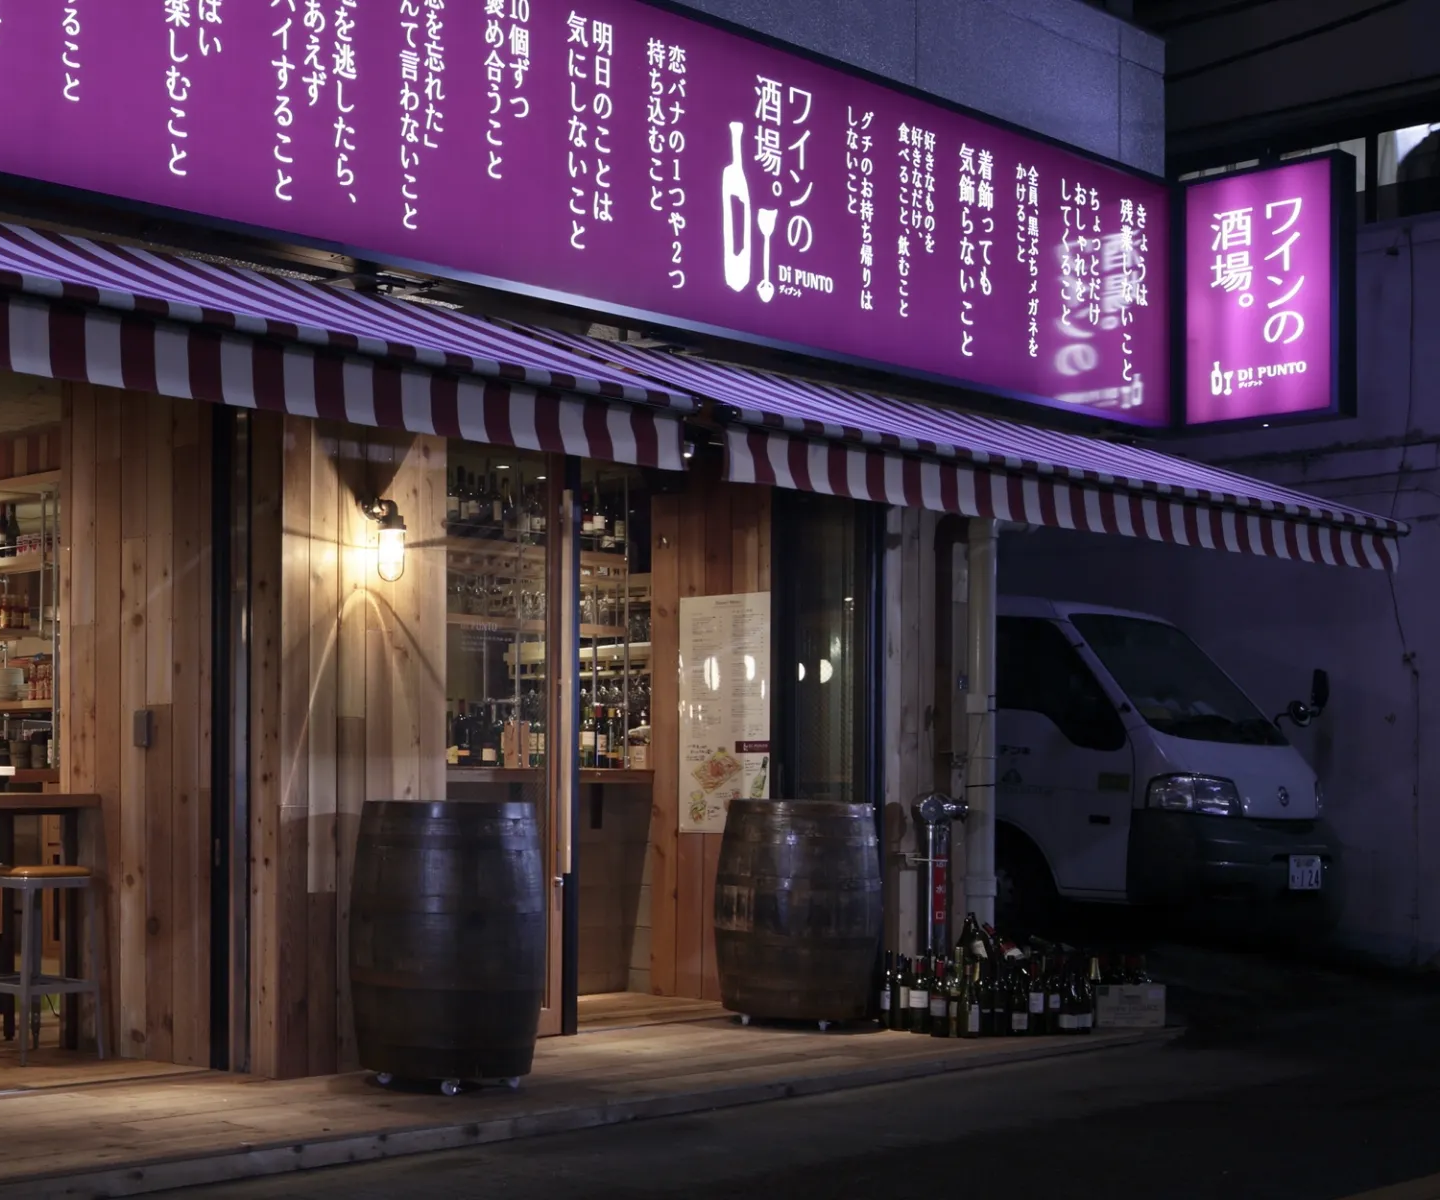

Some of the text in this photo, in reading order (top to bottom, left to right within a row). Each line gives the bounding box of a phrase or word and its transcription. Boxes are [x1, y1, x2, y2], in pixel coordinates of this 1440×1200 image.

[62, 0, 81, 102] ること
[164, 0, 191, 176] 楽しむこと
[331, 0, 357, 203] を逃したら、
[508, 0, 530, 118] 10個ずつ
[592, 19, 613, 222] 明日のことは
[647, 38, 664, 211] 持ち込むこと
[566, 10, 589, 250] 気にしないこと
[668, 45, 686, 289] 恋バナの1つや2つ
[754, 74, 782, 197] 酒場。
[788, 86, 813, 253] ワインの
[846, 105, 859, 214] しないこと
[911, 126, 923, 238] 好きなだけ、
[922, 130, 936, 253] 好きなものを
[778, 265, 833, 294] Di PUNTO
[859, 111, 874, 310] グチのお持ち帰りは
[897, 122, 911, 318] 食べること、飲むこと
[958, 143, 976, 357] 気飾らないこと
[977, 149, 994, 296] 着飾っても
[1016, 163, 1027, 263] かけること
[1026, 165, 1040, 358] 全員、黒ぶちメガネを
[1060, 178, 1073, 326] してくること
[1074, 182, 1088, 302] おしゃれを
[1089, 188, 1101, 325] ちょっとだけ
[1136, 203, 1148, 307] きょうは
[1210, 207, 1253, 308] 酒場。
[1263, 197, 1305, 344] ワインの
[1119, 199, 1135, 382] 残業しないこと
[1257, 360, 1307, 378] PUNTO
